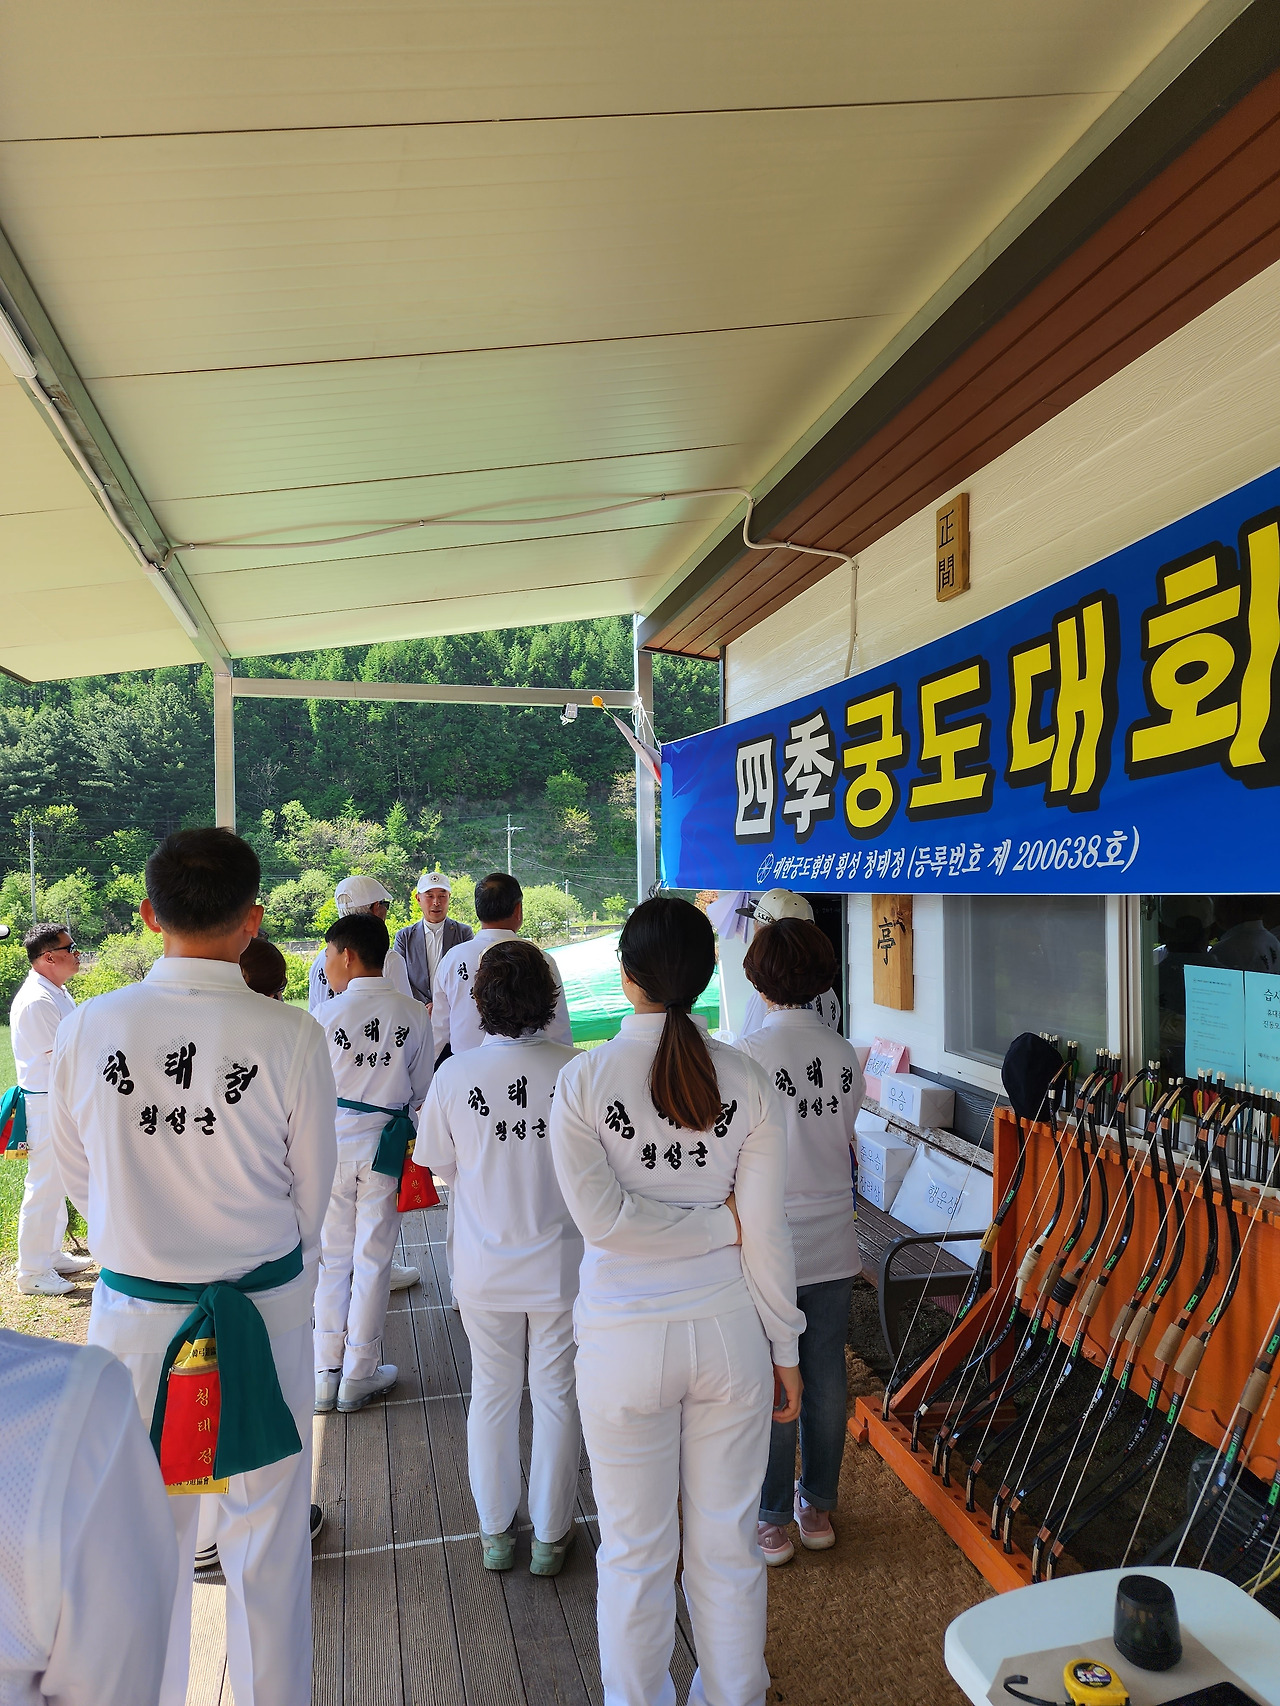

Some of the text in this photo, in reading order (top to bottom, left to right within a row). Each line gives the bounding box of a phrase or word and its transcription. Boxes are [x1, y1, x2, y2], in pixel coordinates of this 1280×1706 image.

[938, 509, 955, 593] 正間
[773, 825, 1140, 880] 대한궁도협회 횡성 청태정 (등록번호 제 200638호)
[354, 1051, 392, 1068] 횡성군
[467, 1075, 556, 1117] 청태
[798, 1094, 839, 1119] 횡성군
[888, 1086, 906, 1112] 우승
[138, 1104, 217, 1136] 횡성군
[495, 1117, 547, 1142] 횡성군
[604, 1099, 738, 1140] 청정
[640, 1141, 709, 1170] 횡성군
[860, 1145, 881, 1171] 준우승
[927, 1183, 960, 1216] 행운상
[195, 1386, 213, 1466] 청태정
